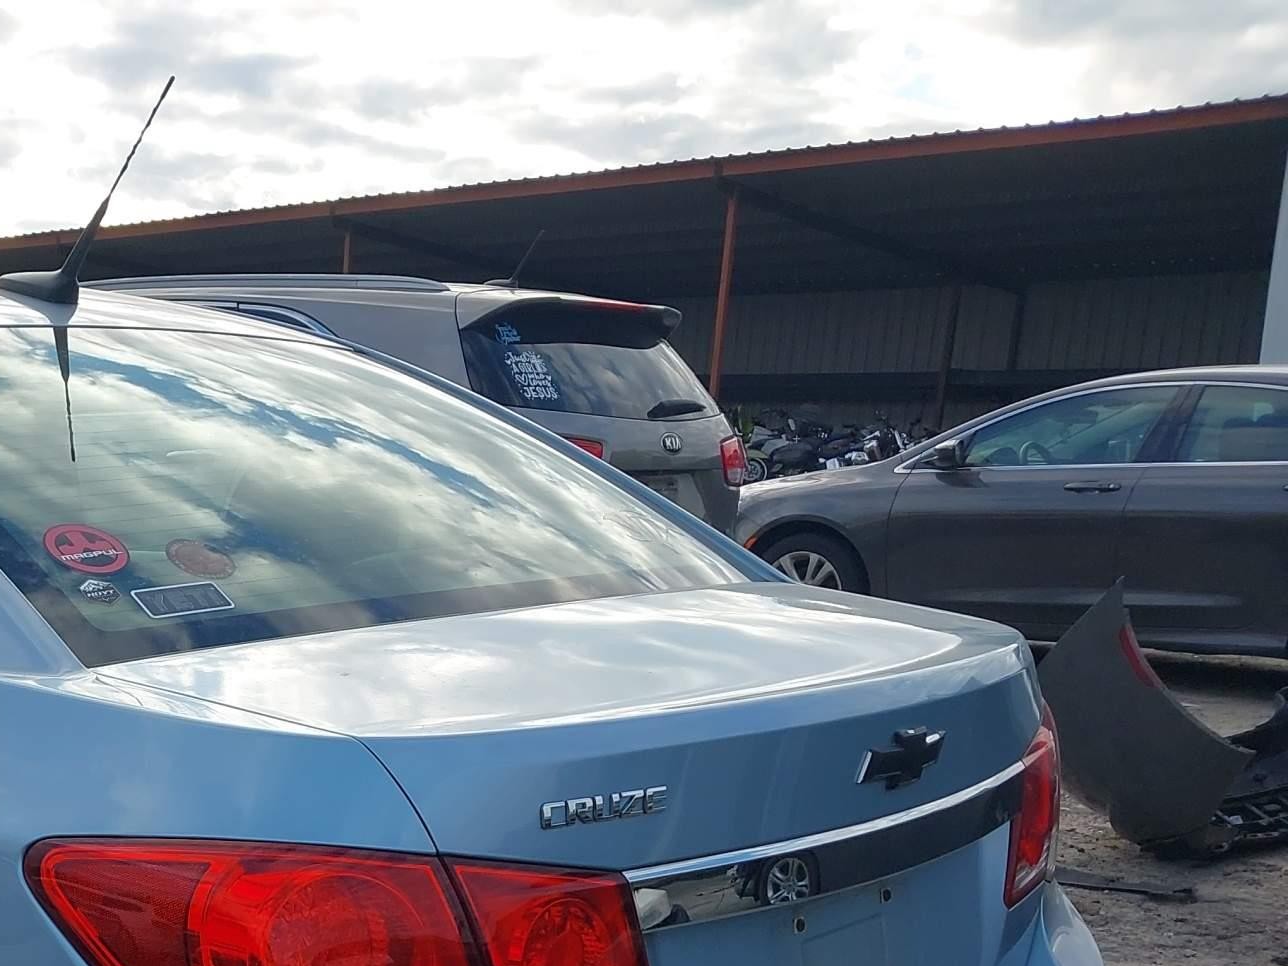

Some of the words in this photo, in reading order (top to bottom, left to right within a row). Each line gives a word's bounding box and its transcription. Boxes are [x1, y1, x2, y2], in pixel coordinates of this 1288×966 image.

[523, 386, 558, 399] JESUS
[60, 549, 125, 561] MAGPUL
[540, 784, 668, 830] CRUZE
